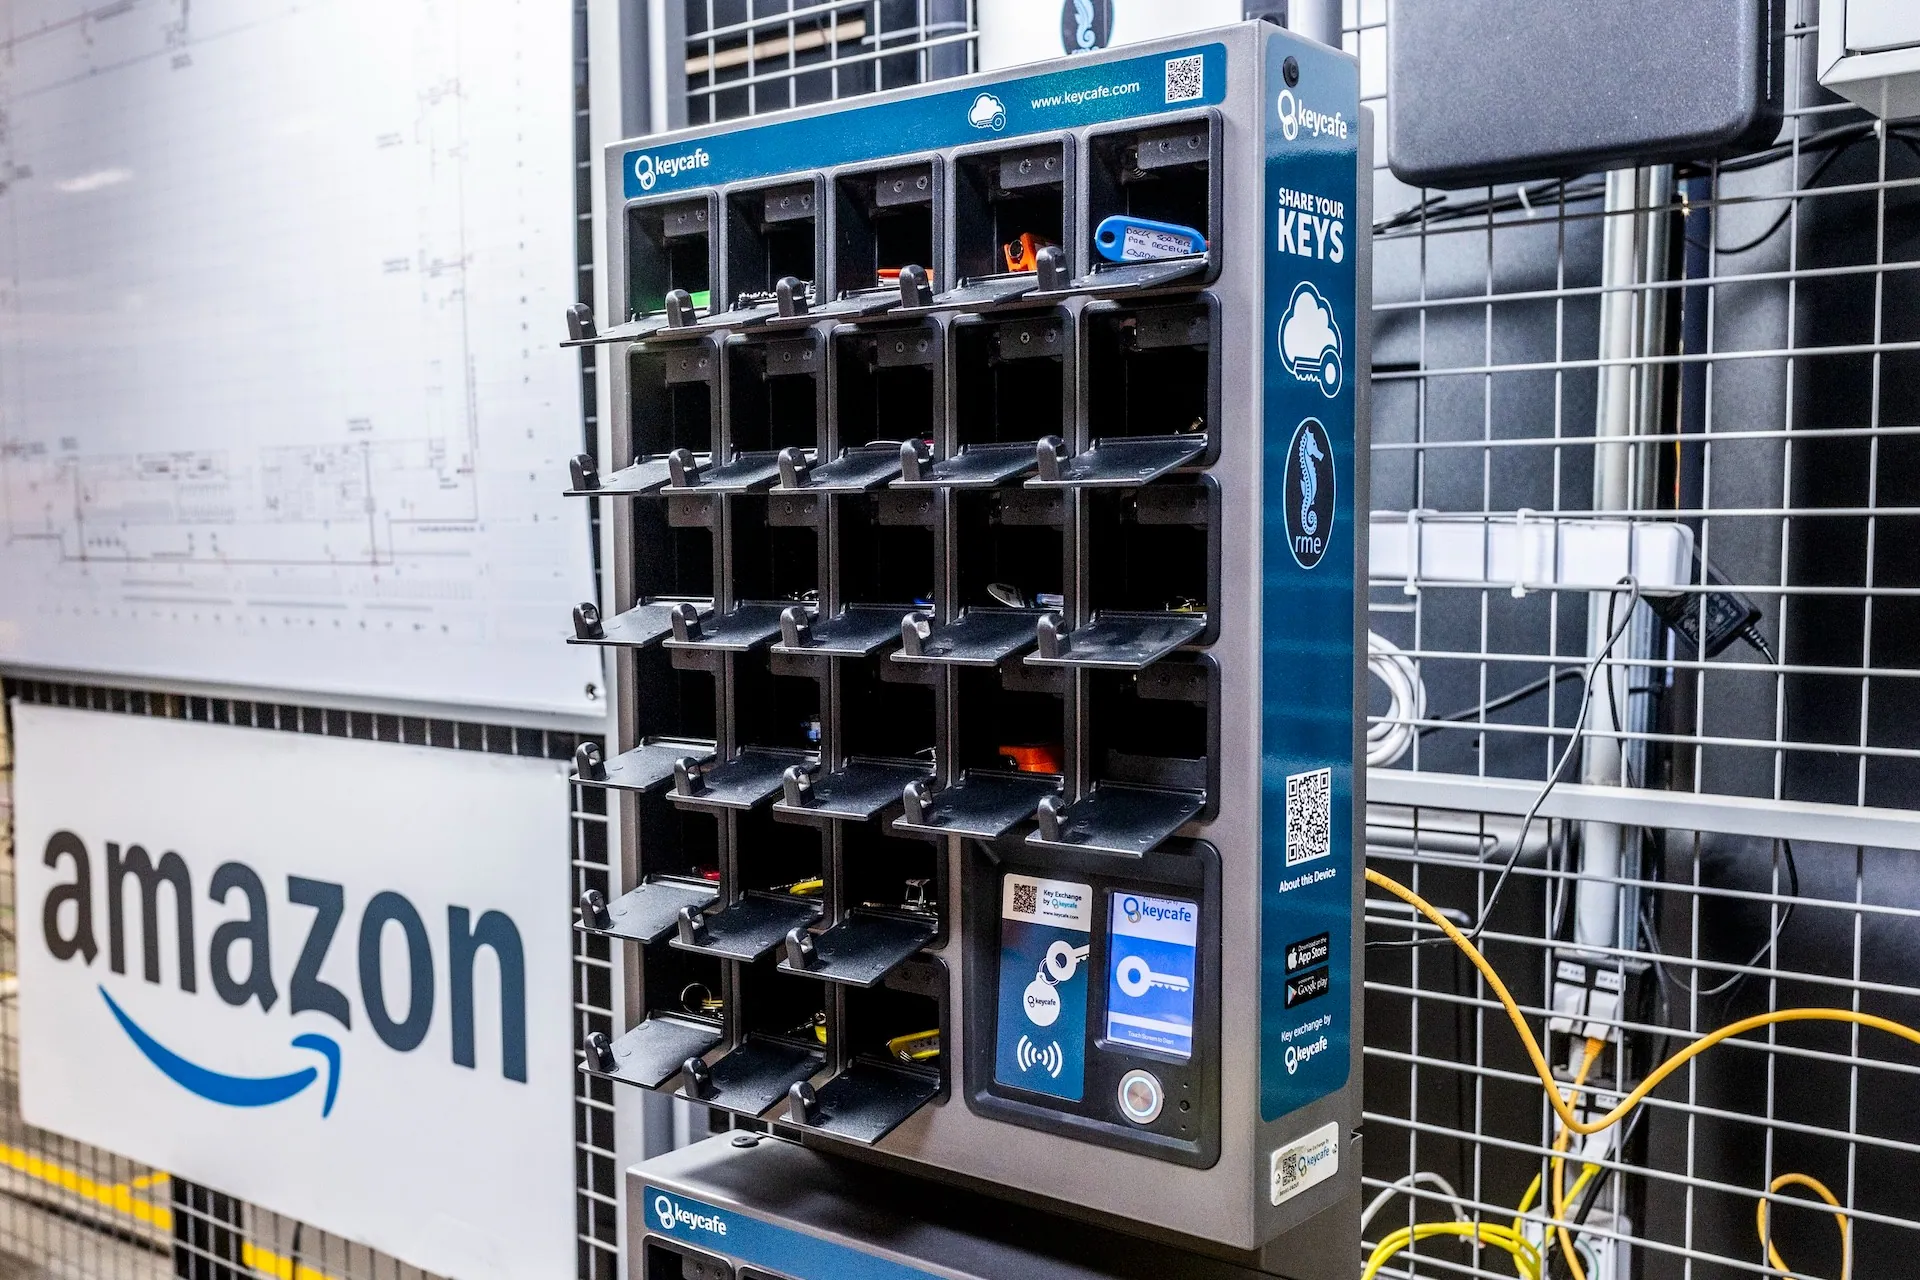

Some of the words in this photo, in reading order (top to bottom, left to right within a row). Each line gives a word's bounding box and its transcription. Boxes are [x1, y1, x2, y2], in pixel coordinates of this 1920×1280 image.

[1031, 80, 1140, 110] www.keycafe.com
[1299, 99, 1348, 139] keycafe
[655, 148, 709, 178] keycafe
[1278, 187, 1314, 212] SHARE
[1315, 195, 1344, 219] YOUR
[1277, 208, 1344, 263] KEYS
[1295, 535, 1322, 554] rme
[1278, 877, 1301, 894] About
[1301, 873, 1314, 887] this
[1314, 867, 1337, 882] Device
[1042, 898, 1050, 906] by
[1043, 889, 1054, 898] Key
[1054, 891, 1082, 901] Exchange
[1042, 911, 1079, 920] www.keycafe.com
[1142, 901, 1192, 922] keycafe
[42, 829, 528, 1084] amazon
[1298, 951, 1312, 966] App
[1311, 945, 1327, 959] Store
[1297, 980, 1316, 996] Google
[1316, 977, 1328, 991] play
[1035, 997, 1057, 1007] keycafe
[1128, 1030, 1141, 1038] Touch
[1281, 1031, 1293, 1042] Key
[1293, 1020, 1323, 1038] exchange
[1323, 1014, 1332, 1026] by
[1297, 1036, 1328, 1062] keycafe
[1307, 1146, 1330, 1166] keycafe
[674, 1203, 727, 1236] keycafe
